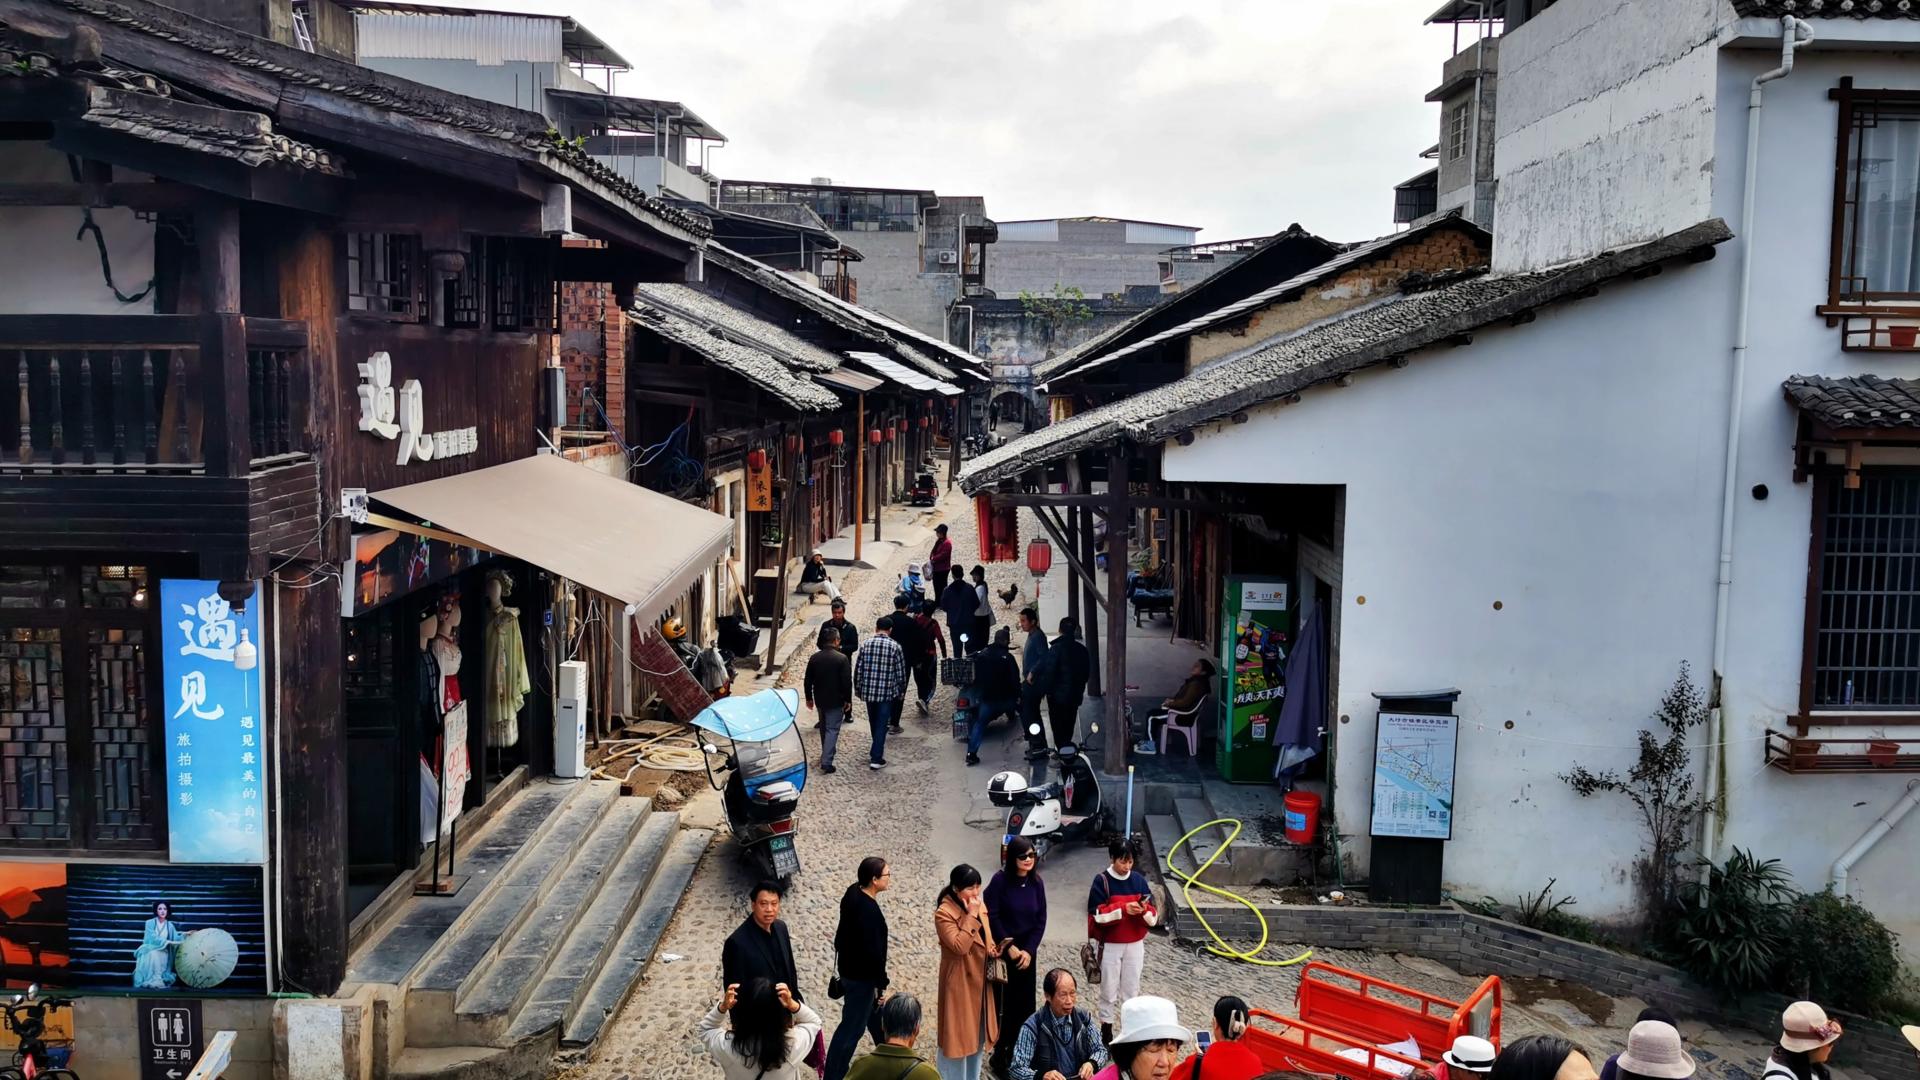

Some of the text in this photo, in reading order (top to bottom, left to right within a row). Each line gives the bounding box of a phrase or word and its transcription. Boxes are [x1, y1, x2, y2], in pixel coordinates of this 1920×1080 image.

[173, 592, 237, 720] 遇见
[177, 732, 193, 806] 旅拍摄影
[240, 716, 256, 833] 遇见最美的自己
[153, 1049, 191, 1060] 卫生间
